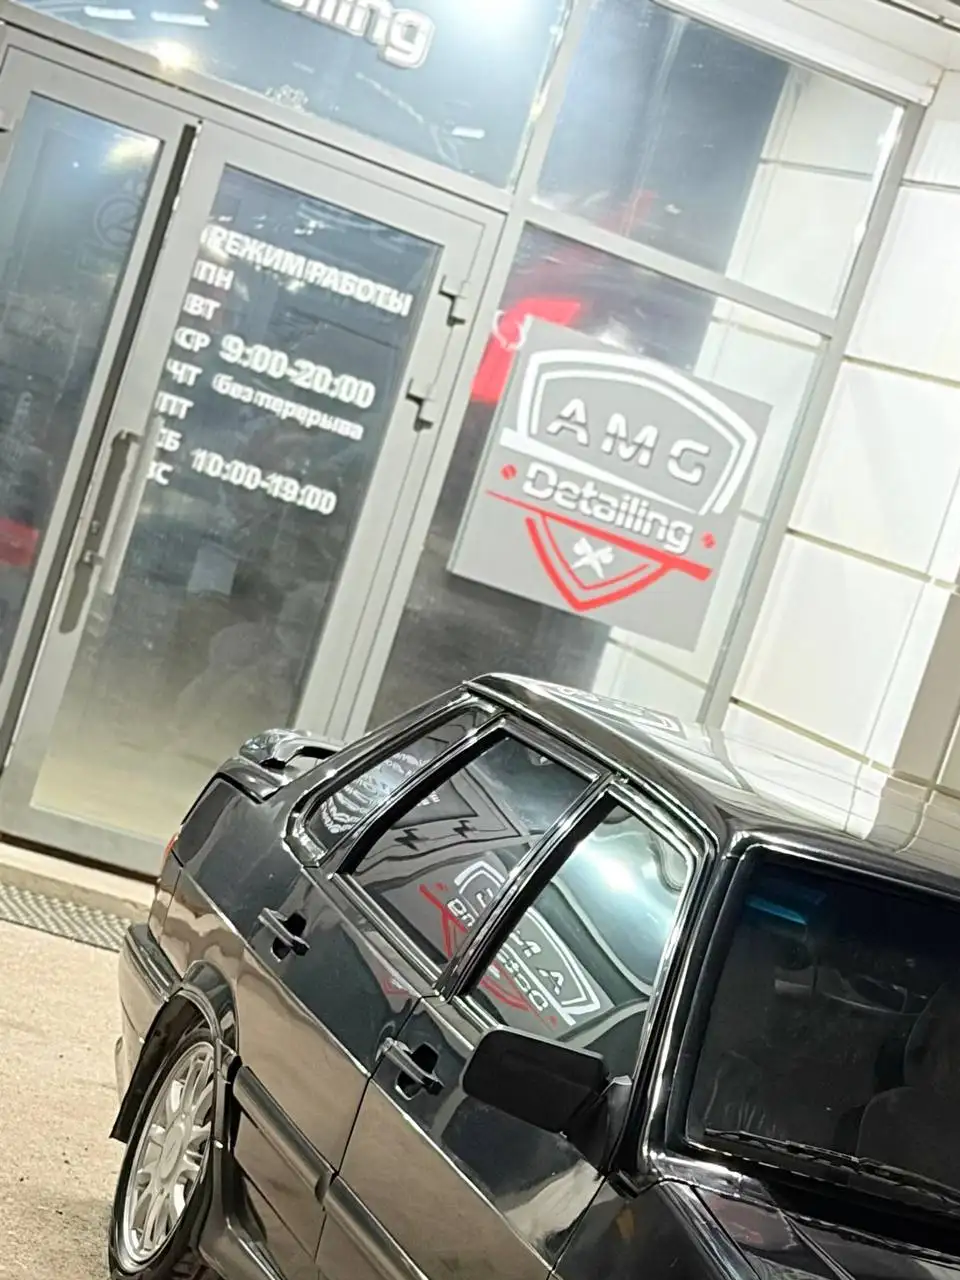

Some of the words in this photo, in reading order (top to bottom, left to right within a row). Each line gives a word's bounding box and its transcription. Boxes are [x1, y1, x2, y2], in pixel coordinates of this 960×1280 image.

[194, 259, 235, 291] ПН
[303, 260, 413, 317] РАБОТЫ
[182, 292, 221, 321] ВТ
[166, 358, 203, 387] ЧТ
[174, 326, 211, 352] СР
[218, 333, 376, 410] 9:00-20:00
[546, 398, 711, 486] AMG
[190, 448, 337, 515] 10:00-19:00
[522, 461, 695, 554] Detailing
